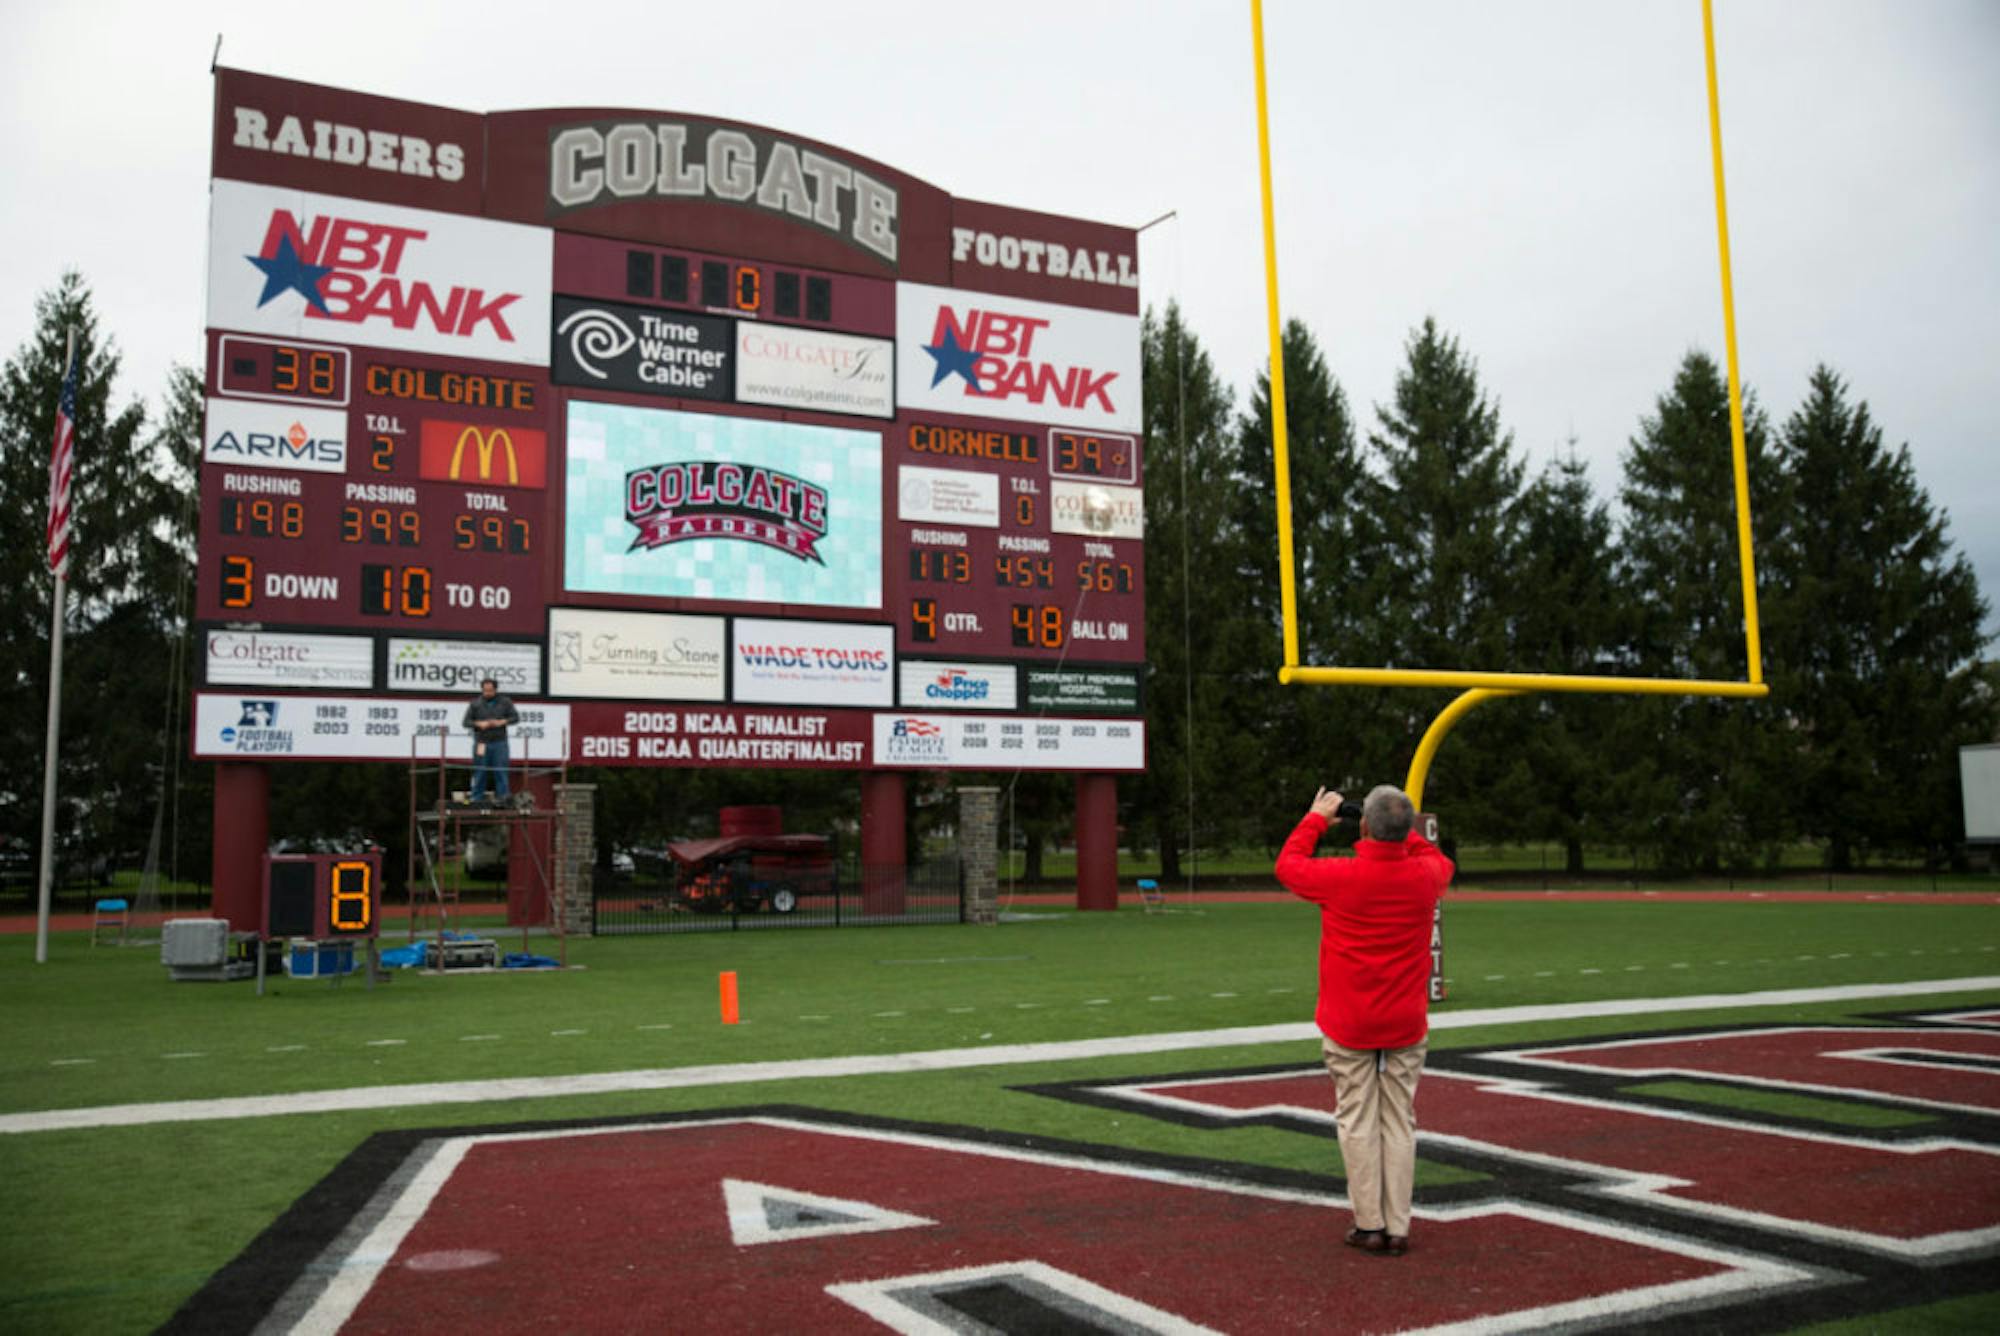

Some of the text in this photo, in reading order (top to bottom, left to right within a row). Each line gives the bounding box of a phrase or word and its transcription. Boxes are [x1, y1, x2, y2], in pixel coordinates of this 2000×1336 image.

[233, 107, 465, 181] RAIDERS
[551, 123, 897, 262] COLGATE
[257, 208, 428, 275] NBT
[952, 227, 1138, 287] FOOTBALL
[304, 270, 523, 342] BANK
[639, 315, 699, 343] Time
[931, 305, 1049, 358] NBT
[638, 338, 725, 369] Warner
[742, 335, 853, 369] COLGATE
[275, 348, 335, 395] 38
[638, 361, 707, 388] Cable
[964, 354, 1119, 414] BANK
[366, 366, 534, 410] COLGATE
[746, 383, 886, 407] www.colgateinn.com
[366, 415, 405, 434] T.O.L.
[211, 431, 342, 463] ARMS
[372, 436, 394, 471] 2
[1060, 435, 1102, 473] 39
[224, 474, 301, 496] RUSHING
[346, 484, 416, 504] PASSING
[627, 463, 825, 531] COLGATE
[1011, 477, 1040, 494] T.O.L.
[465, 493, 508, 511] TOTAL
[1016, 495, 1033, 526] 0
[234, 500, 303, 537] 198
[344, 508, 420, 544] 399
[455, 515, 530, 550] 597
[658, 518, 798, 548] RAIDERS
[911, 529, 968, 546] RUSHING
[998, 536, 1050, 553] PASSING
[1084, 543, 1114, 558] TOTAL
[224, 556, 253, 607] 3
[920, 552, 970, 582] 113
[996, 556, 1054, 587] 454
[1078, 561, 1133, 593] 567
[265, 574, 338, 599] DOWN
[383, 567, 431, 616] 10
[446, 583, 511, 609] TO GO
[912, 601, 935, 641] 4
[944, 613, 983, 632] QTR.
[1012, 607, 1062, 648] 48
[1072, 620, 1128, 641] BALL ON
[209, 635, 310, 669] Colgate
[588, 633, 720, 664] Turning Stone
[738, 644, 889, 671] WADE TOURS
[394, 659, 527, 687] imagepress
[952, 675, 989, 689] Price
[926, 684, 989, 700] Chopper
[316, 705, 347, 718] 1982
[367, 706, 398, 720] 1983
[418, 708, 448, 720] 1997
[624, 712, 827, 736] 2003 NCAA FINALIST
[239, 729, 293, 741] FOOTBALL
[313, 722, 349, 734] 2003
[365, 723, 400, 736] 2005
[237, 741, 293, 752] PLAYOFFS
[583, 737, 864, 762] 2015 NCAA QUARTERFINALIST
[331, 861, 370, 930] 8
